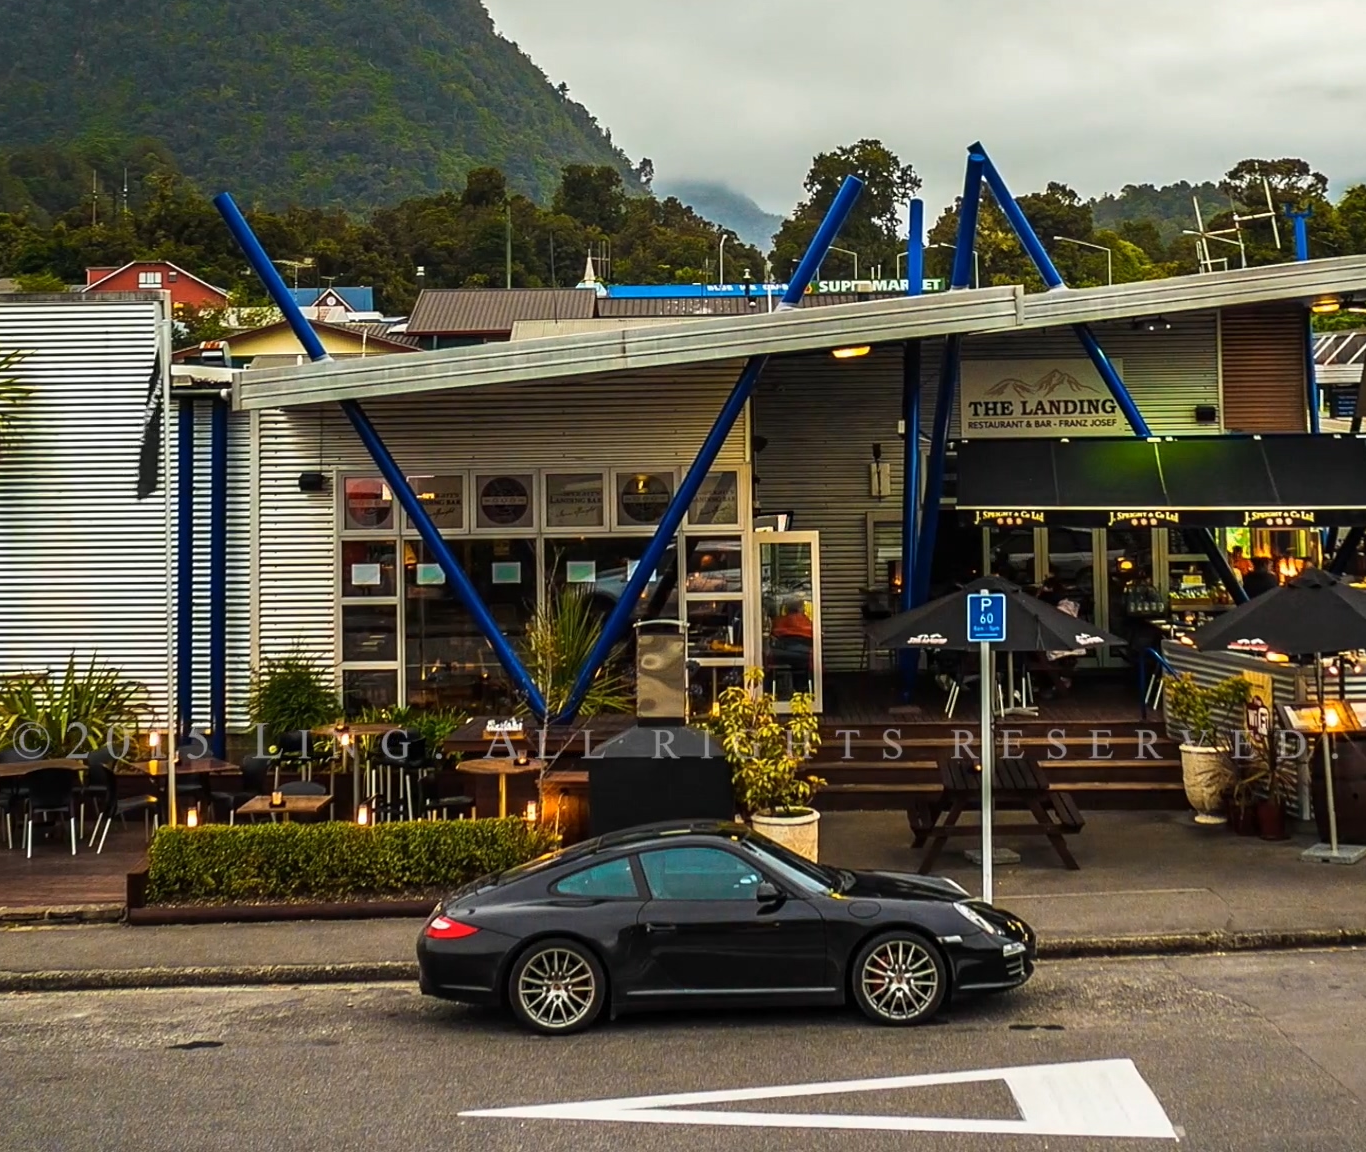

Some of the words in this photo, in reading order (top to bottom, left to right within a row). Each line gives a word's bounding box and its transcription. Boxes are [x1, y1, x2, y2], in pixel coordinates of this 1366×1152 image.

[818, 278, 942, 293] SUPMARET
[968, 401, 1014, 416] THE
[1020, 399, 1117, 416] LANDING
[968, 420, 1023, 429] RESTAURANT
[1035, 420, 1052, 428] BAR
[1059, 419, 1088, 427] FRANZ
[1090, 419, 1117, 427] JOSEF
[981, 598, 992, 612] P
[980, 612, 994, 624] 60
